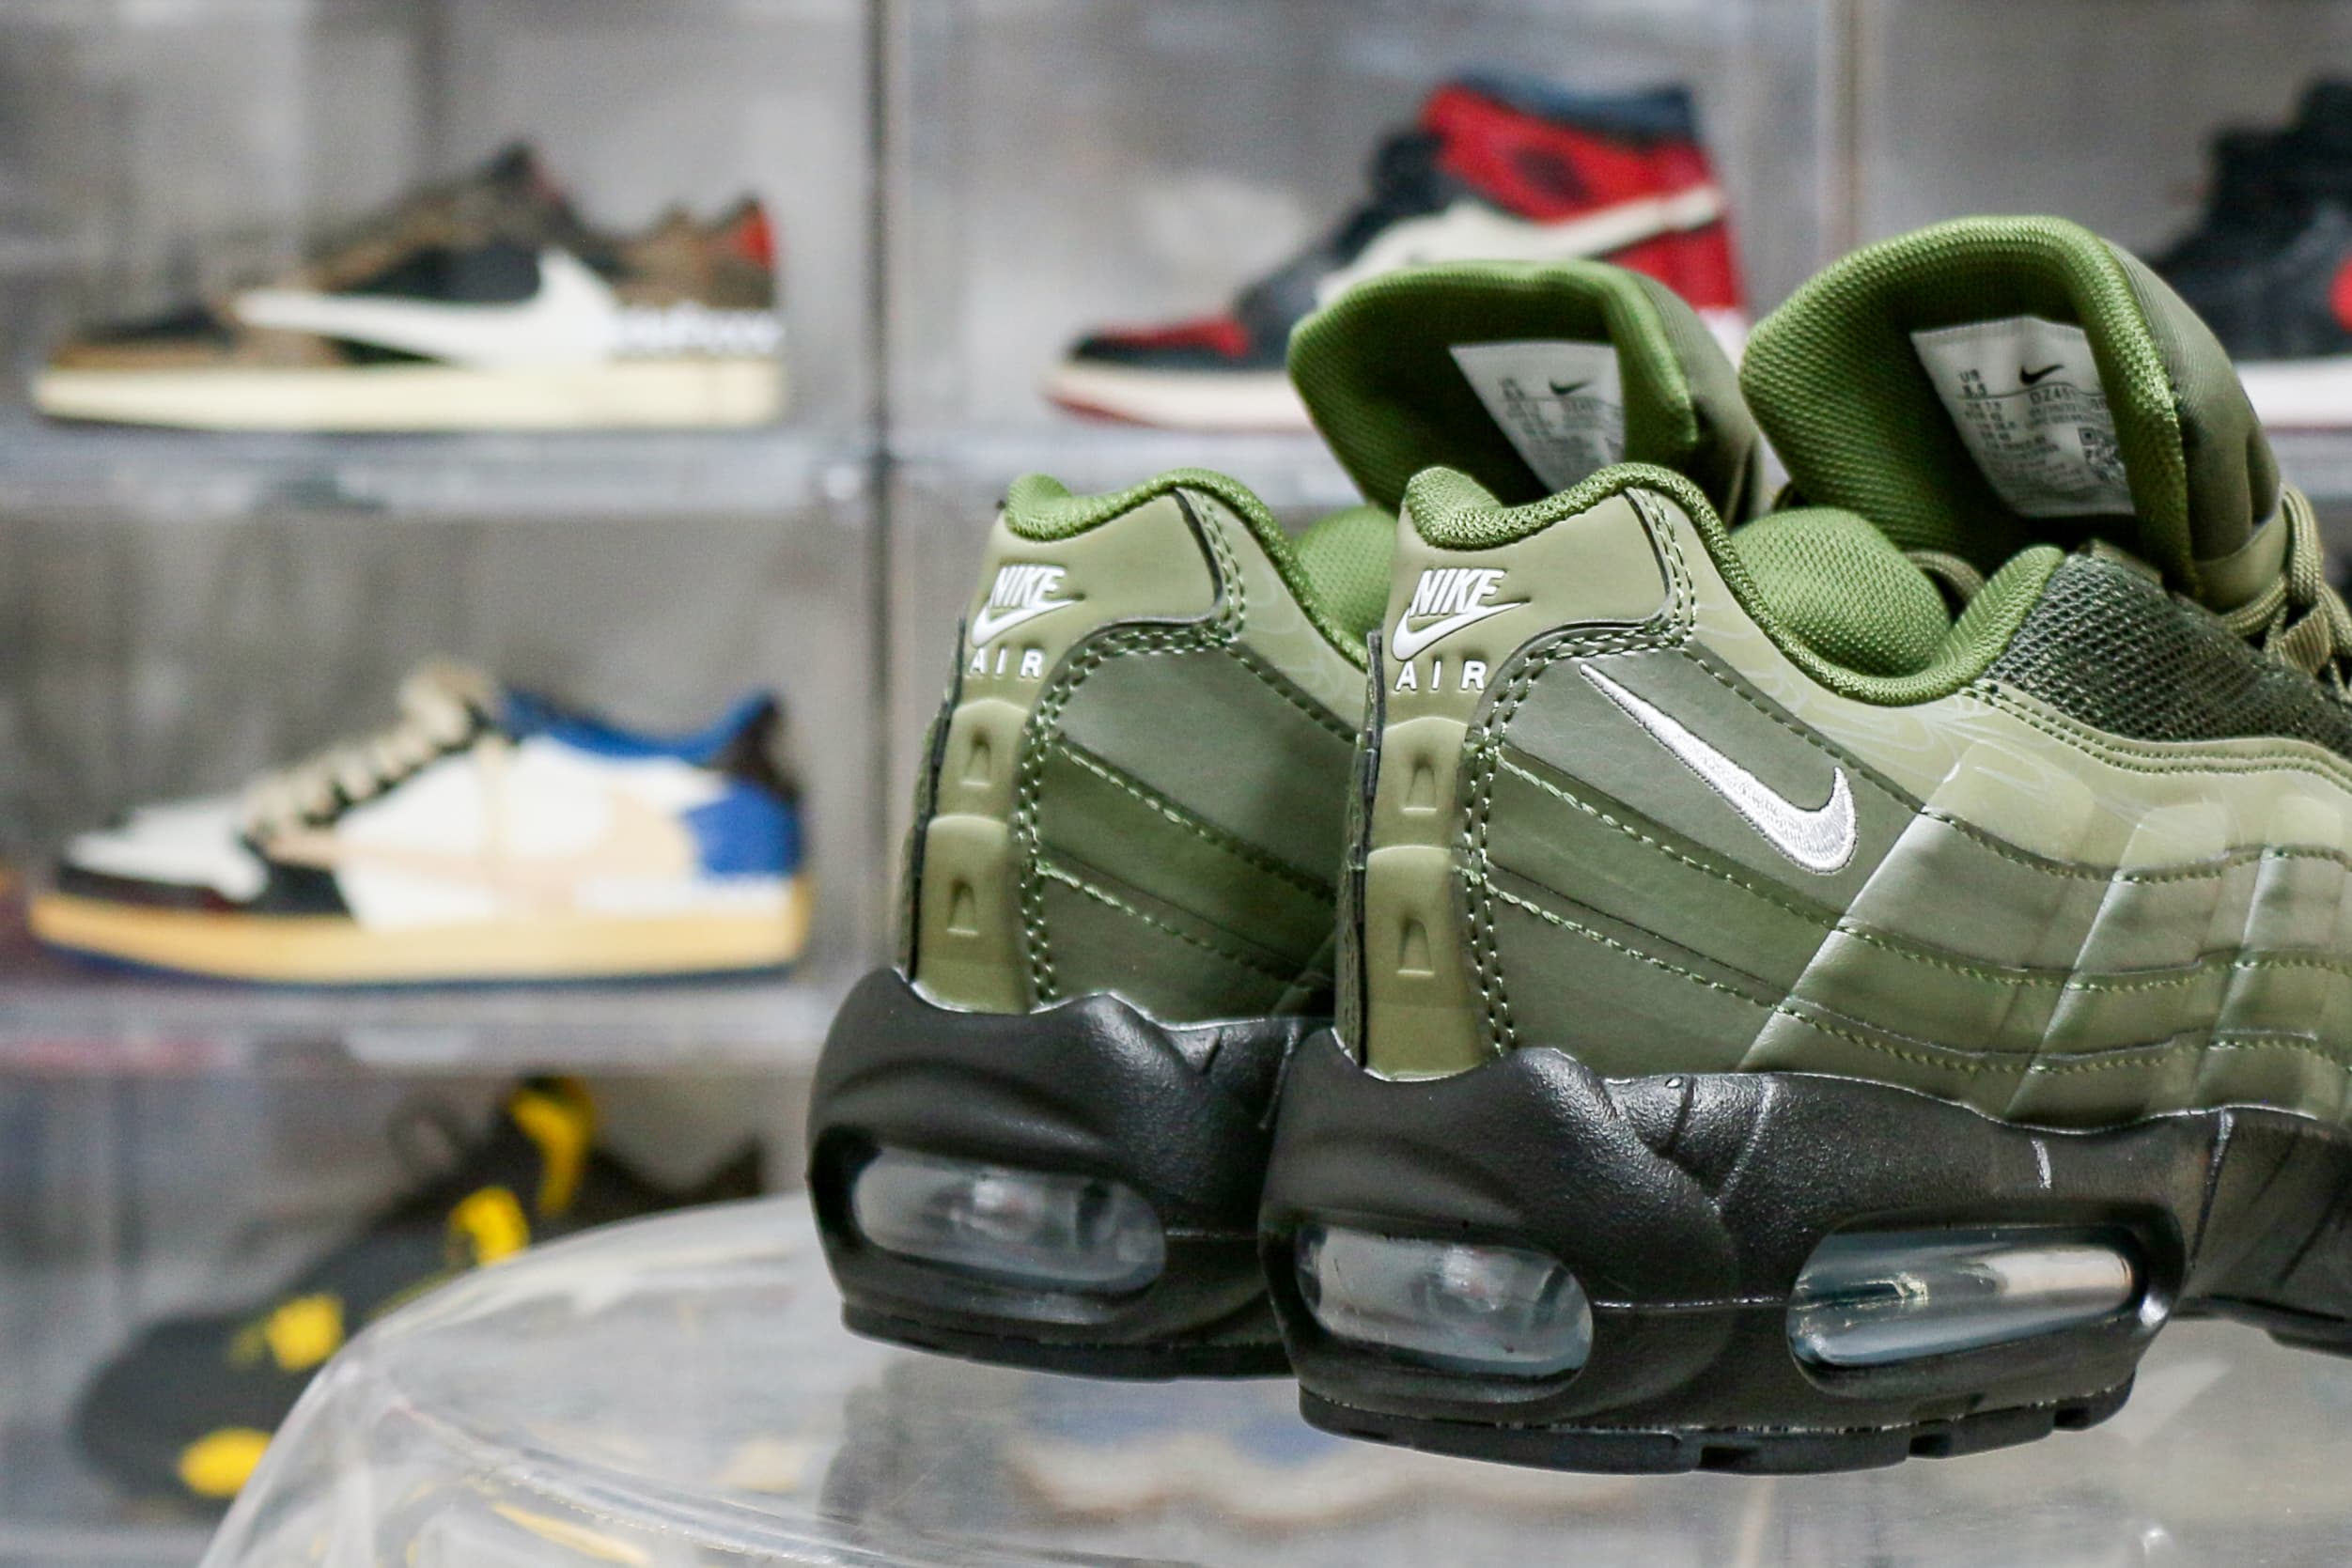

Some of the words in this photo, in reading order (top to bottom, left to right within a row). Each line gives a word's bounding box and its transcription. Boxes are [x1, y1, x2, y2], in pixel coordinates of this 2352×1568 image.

[989, 564, 1067, 609] NIKE
[1409, 568, 1507, 616] NIKE
[969, 646, 1044, 677] AIR
[1394, 660, 1488, 691] AIR
